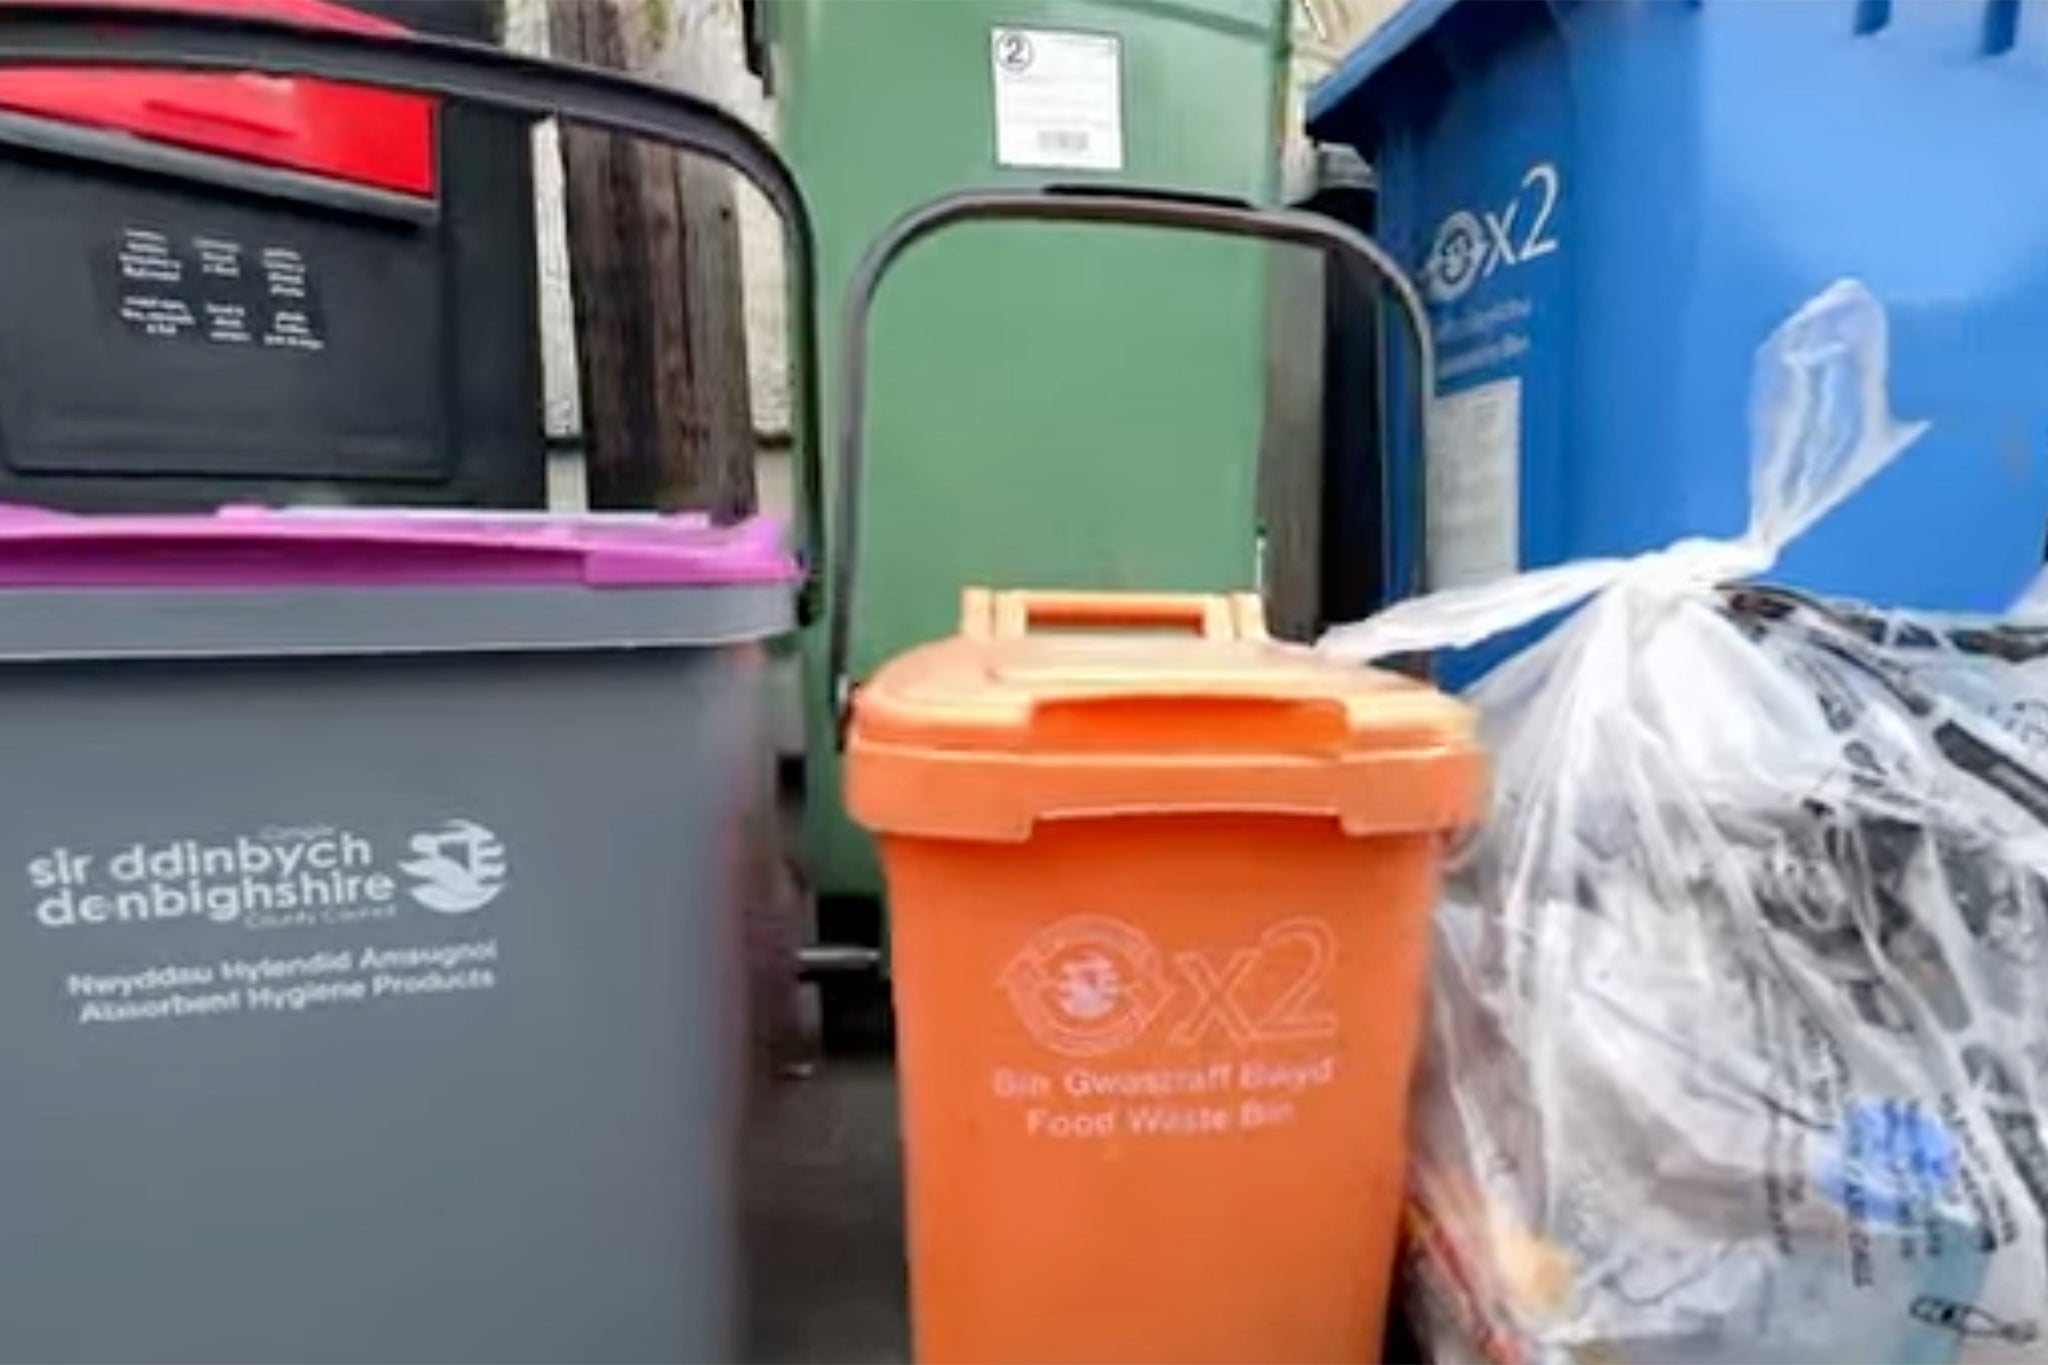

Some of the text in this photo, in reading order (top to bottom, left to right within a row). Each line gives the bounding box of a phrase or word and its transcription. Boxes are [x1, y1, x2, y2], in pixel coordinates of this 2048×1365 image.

[1006, 34, 1024, 63] 2
[1483, 163, 1559, 277] x2
[27, 846, 94, 888] sir
[109, 829, 371, 882] ddinbych
[37, 870, 396, 927] denbighshire
[247, 978, 365, 1010] Hygiene
[371, 967, 495, 998] Products
[1169, 915, 1338, 1050] x2
[1026, 1107, 1115, 1140] Food
[1126, 1105, 1228, 1138] Waste
